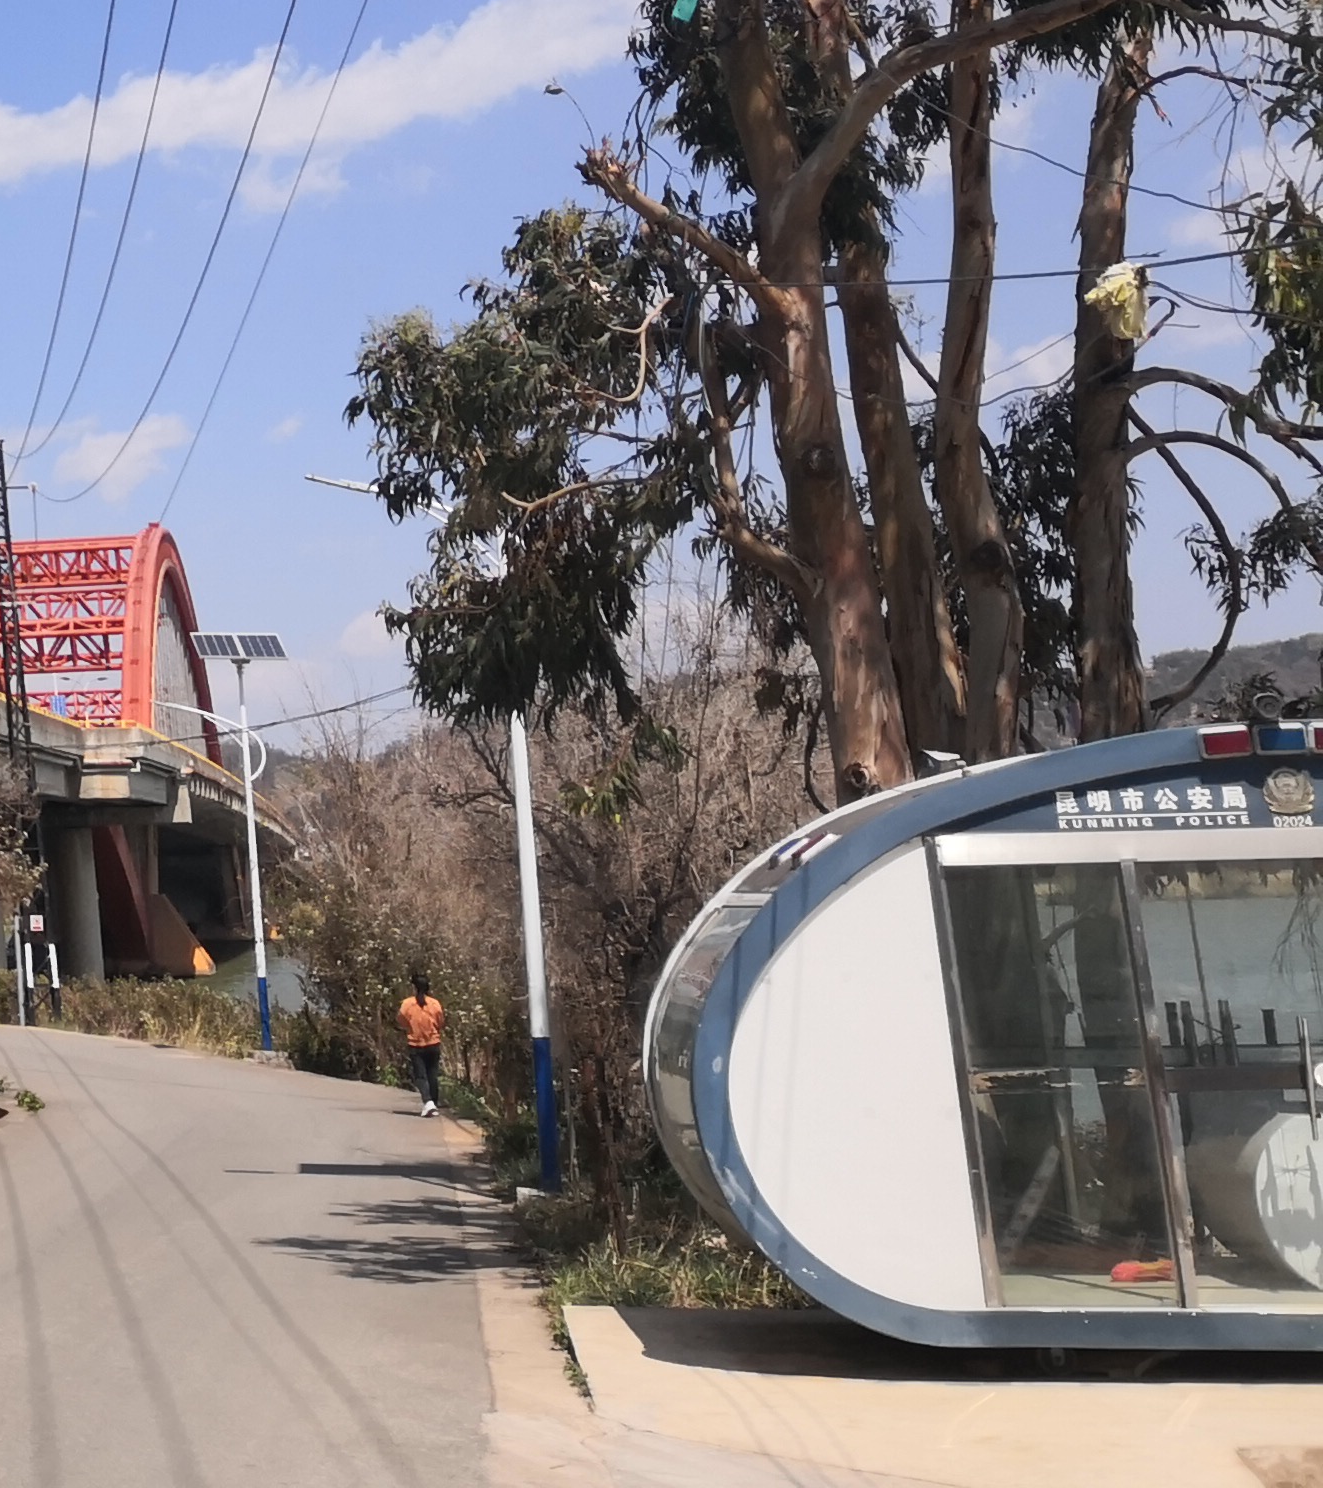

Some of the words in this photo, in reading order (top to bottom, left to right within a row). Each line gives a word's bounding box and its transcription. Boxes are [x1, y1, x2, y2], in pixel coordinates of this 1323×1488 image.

[1055, 786, 1247, 813] 昆明市公安局
[1058, 817, 1154, 829] KUNMING
[1175, 815, 1251, 827] POLICE
[1272, 815, 1313, 828] 02024
